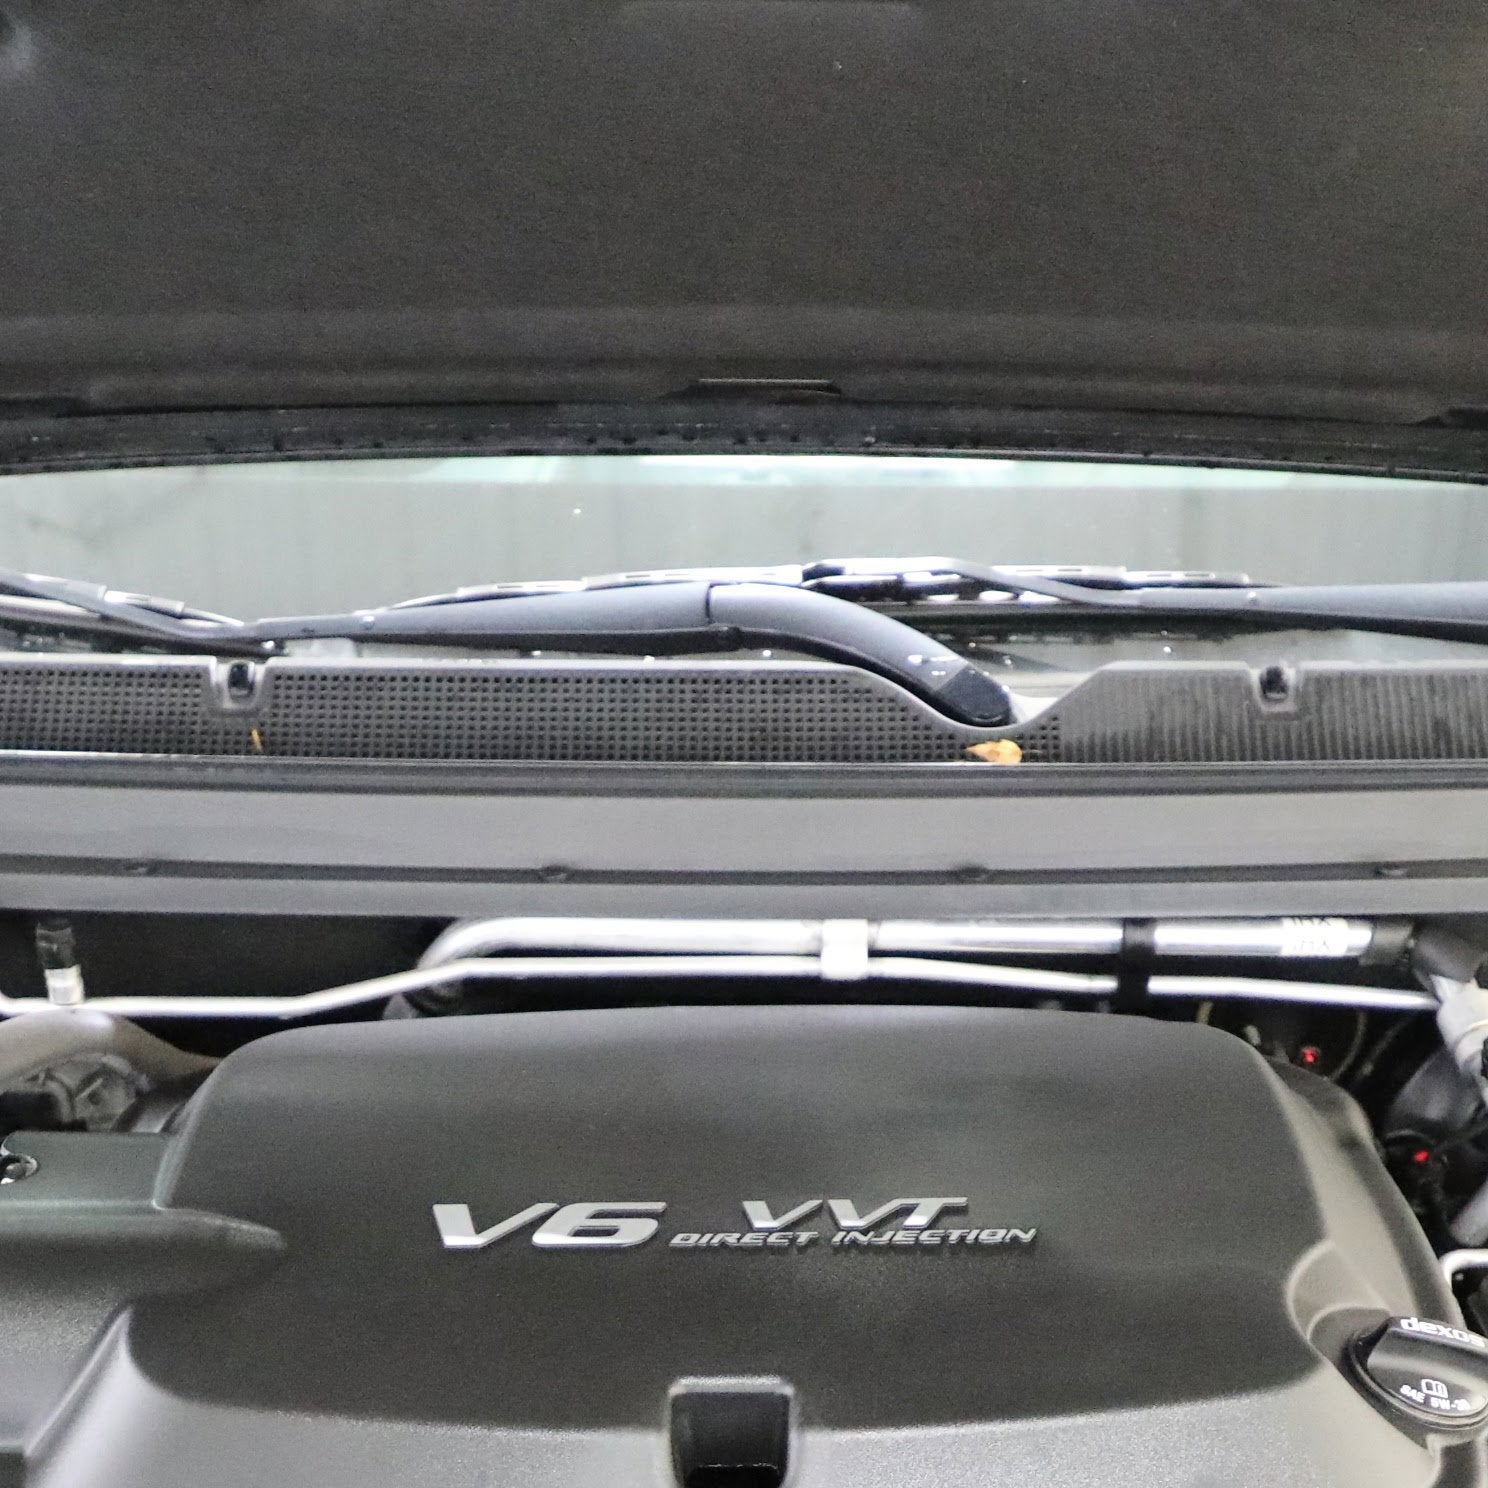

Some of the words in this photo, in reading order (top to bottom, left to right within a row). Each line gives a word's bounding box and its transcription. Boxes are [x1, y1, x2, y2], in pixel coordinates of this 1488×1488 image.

[432, 1201, 667, 1248] V6
[741, 1197, 968, 1231] VVT
[668, 1231, 819, 1247] DIRECT
[830, 1227, 1037, 1246] INJECTION
[1400, 1316, 1486, 1348] dexos
[1399, 1384, 1426, 1403] SAE
